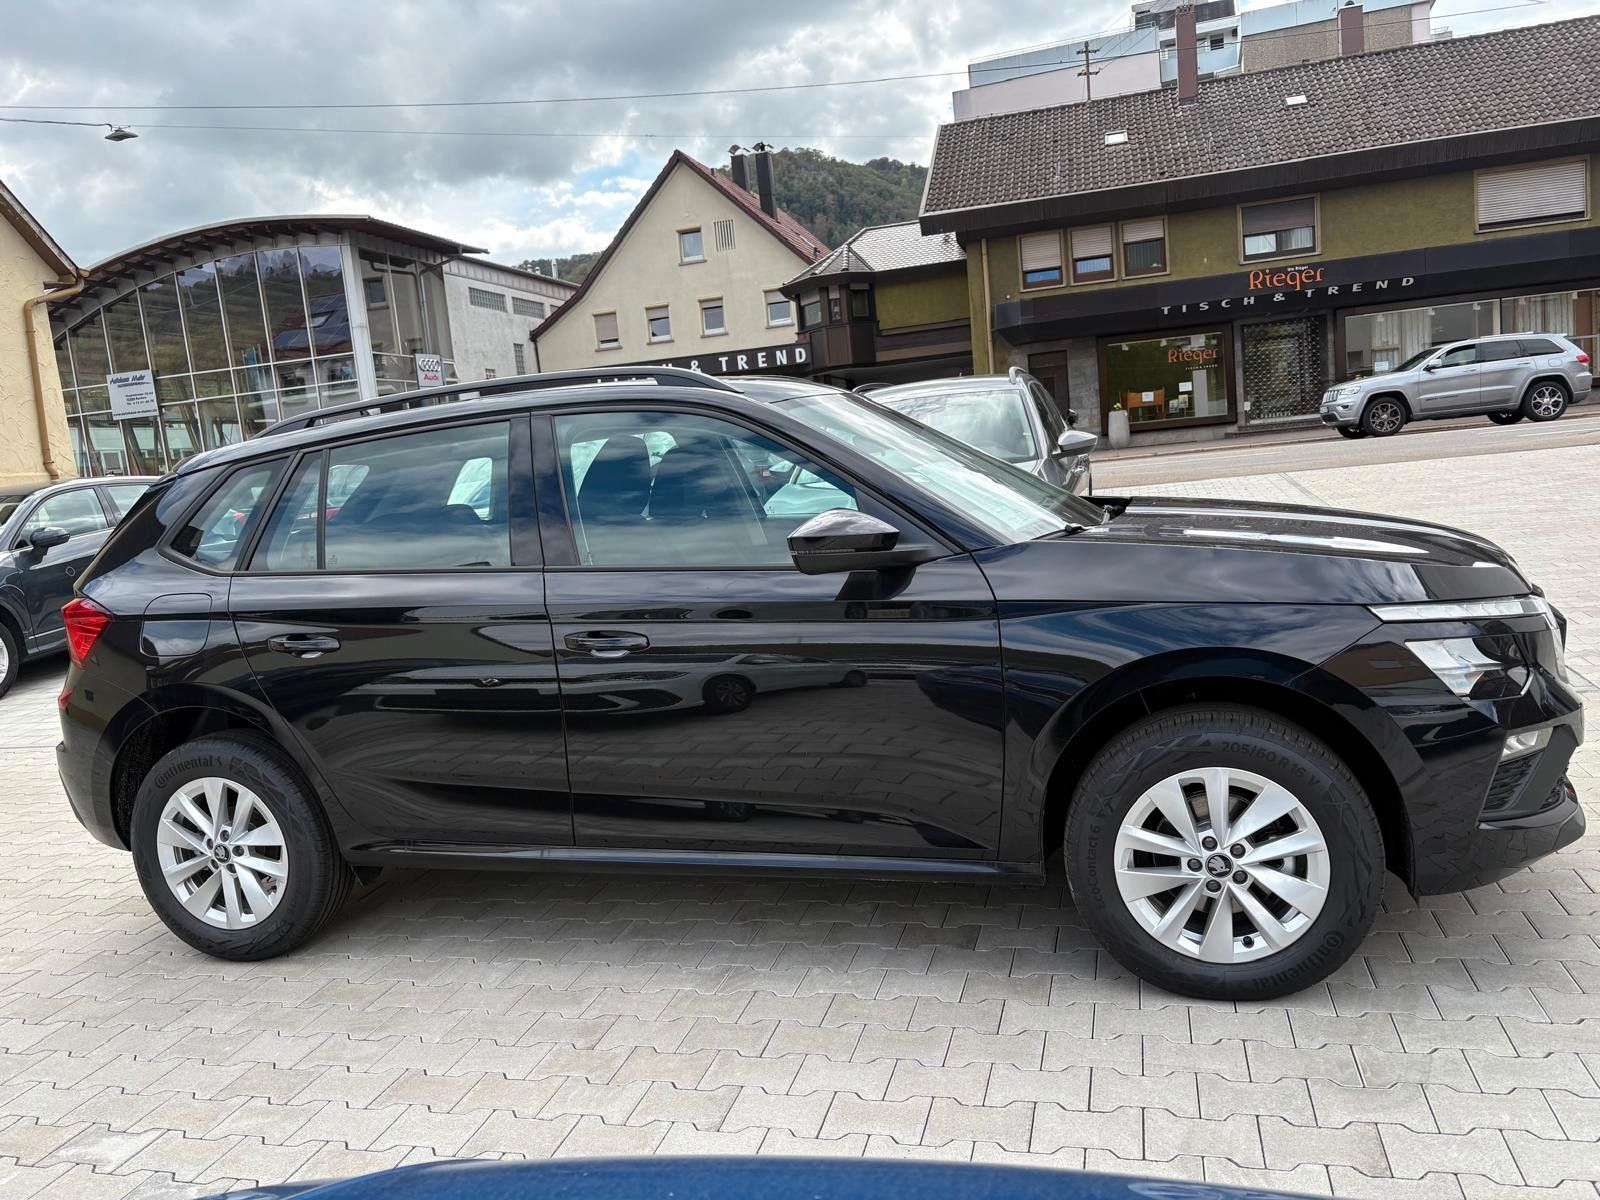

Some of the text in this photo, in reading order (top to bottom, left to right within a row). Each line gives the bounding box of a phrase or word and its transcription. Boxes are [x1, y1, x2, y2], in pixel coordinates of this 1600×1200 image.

[1248, 267, 1325, 291] Rieger
[1161, 277, 1415, 315] TISCH & TREND
[690, 347, 807, 373] & TREND
[1167, 347, 1218, 364] Rieger
